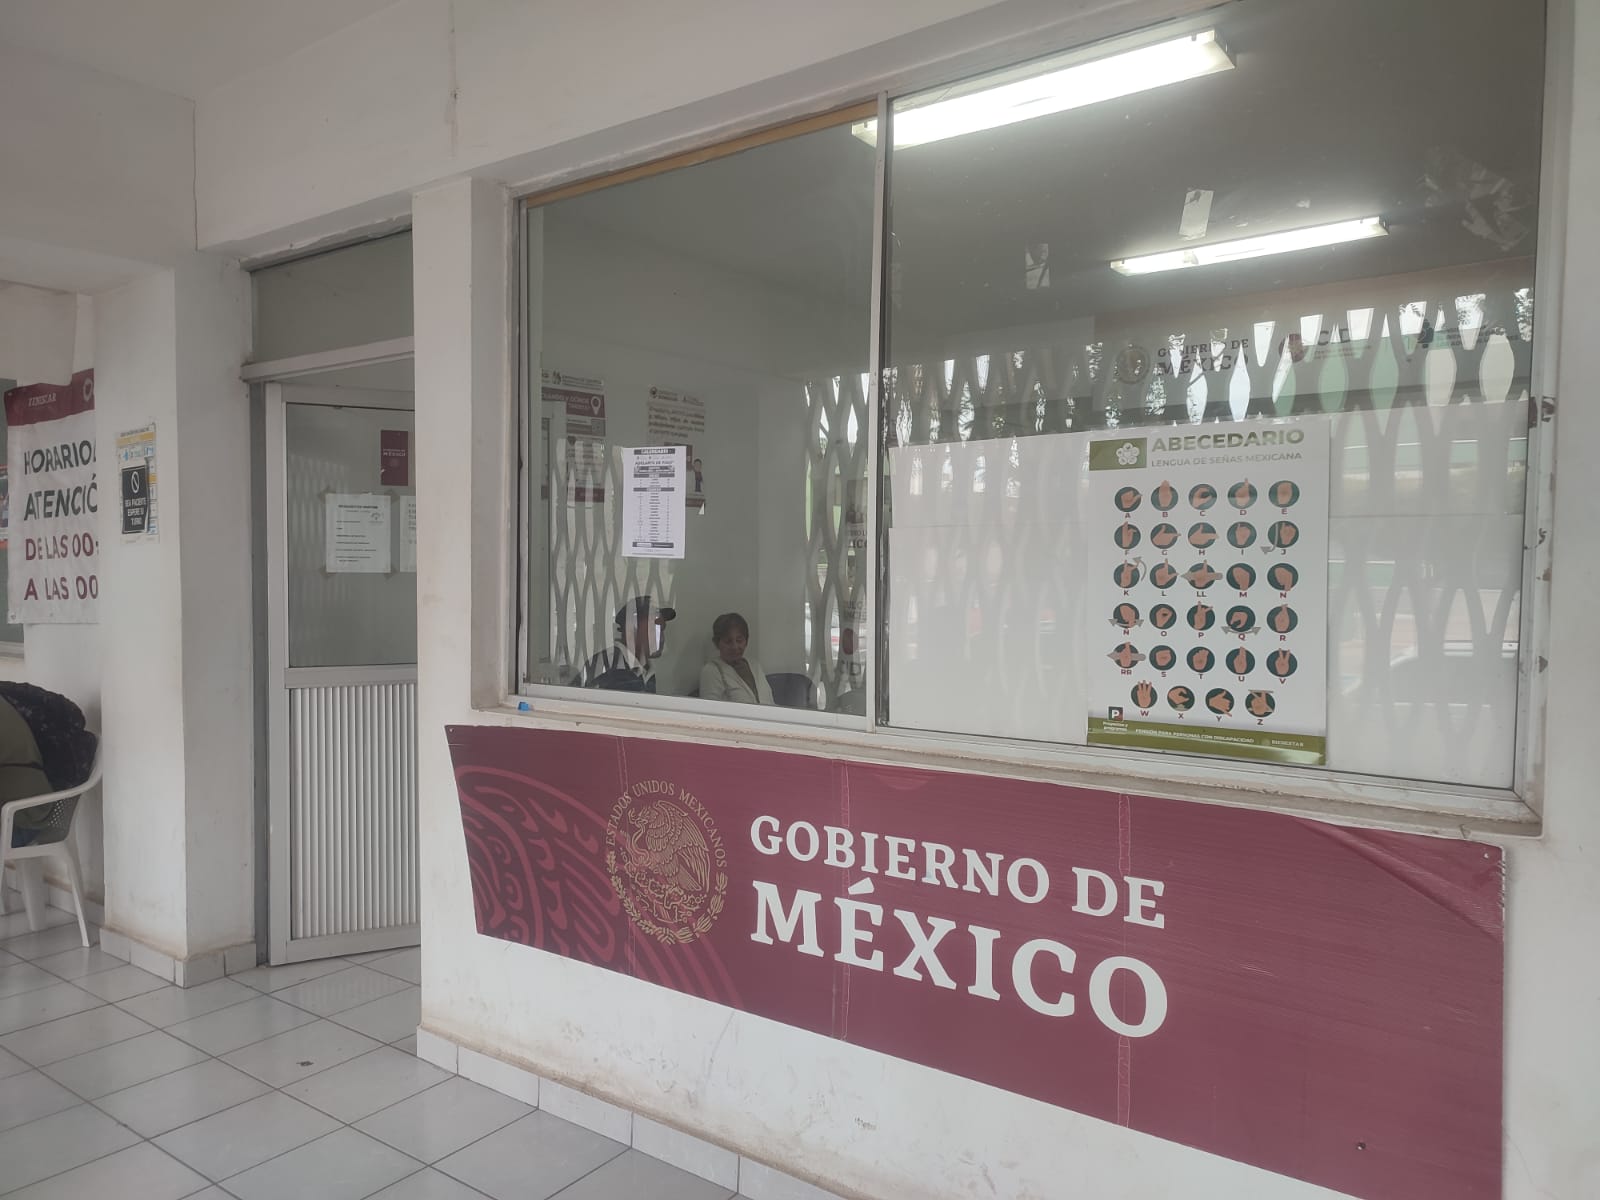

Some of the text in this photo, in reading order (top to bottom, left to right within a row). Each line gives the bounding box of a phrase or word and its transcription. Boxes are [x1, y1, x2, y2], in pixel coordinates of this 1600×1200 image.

[1158, 339, 1248, 357] GIER DE
[1152, 429, 1304, 452] ABECEDARIO
[24, 440, 92, 475] HORARIO
[1152, 452, 1302, 467] LENGUA DE SEÑAS MEXICANA
[25, 537, 43, 560] DE
[44, 534, 68, 560] LAS
[24, 578, 39, 600] A
[44, 576, 69, 600] LAS
[606, 780, 728, 867] ESTADOS UNIDOS MEXICANOS
[750, 815, 1166, 930] GOBIERNO DE
[750, 877, 1168, 1038] MÉXICO
